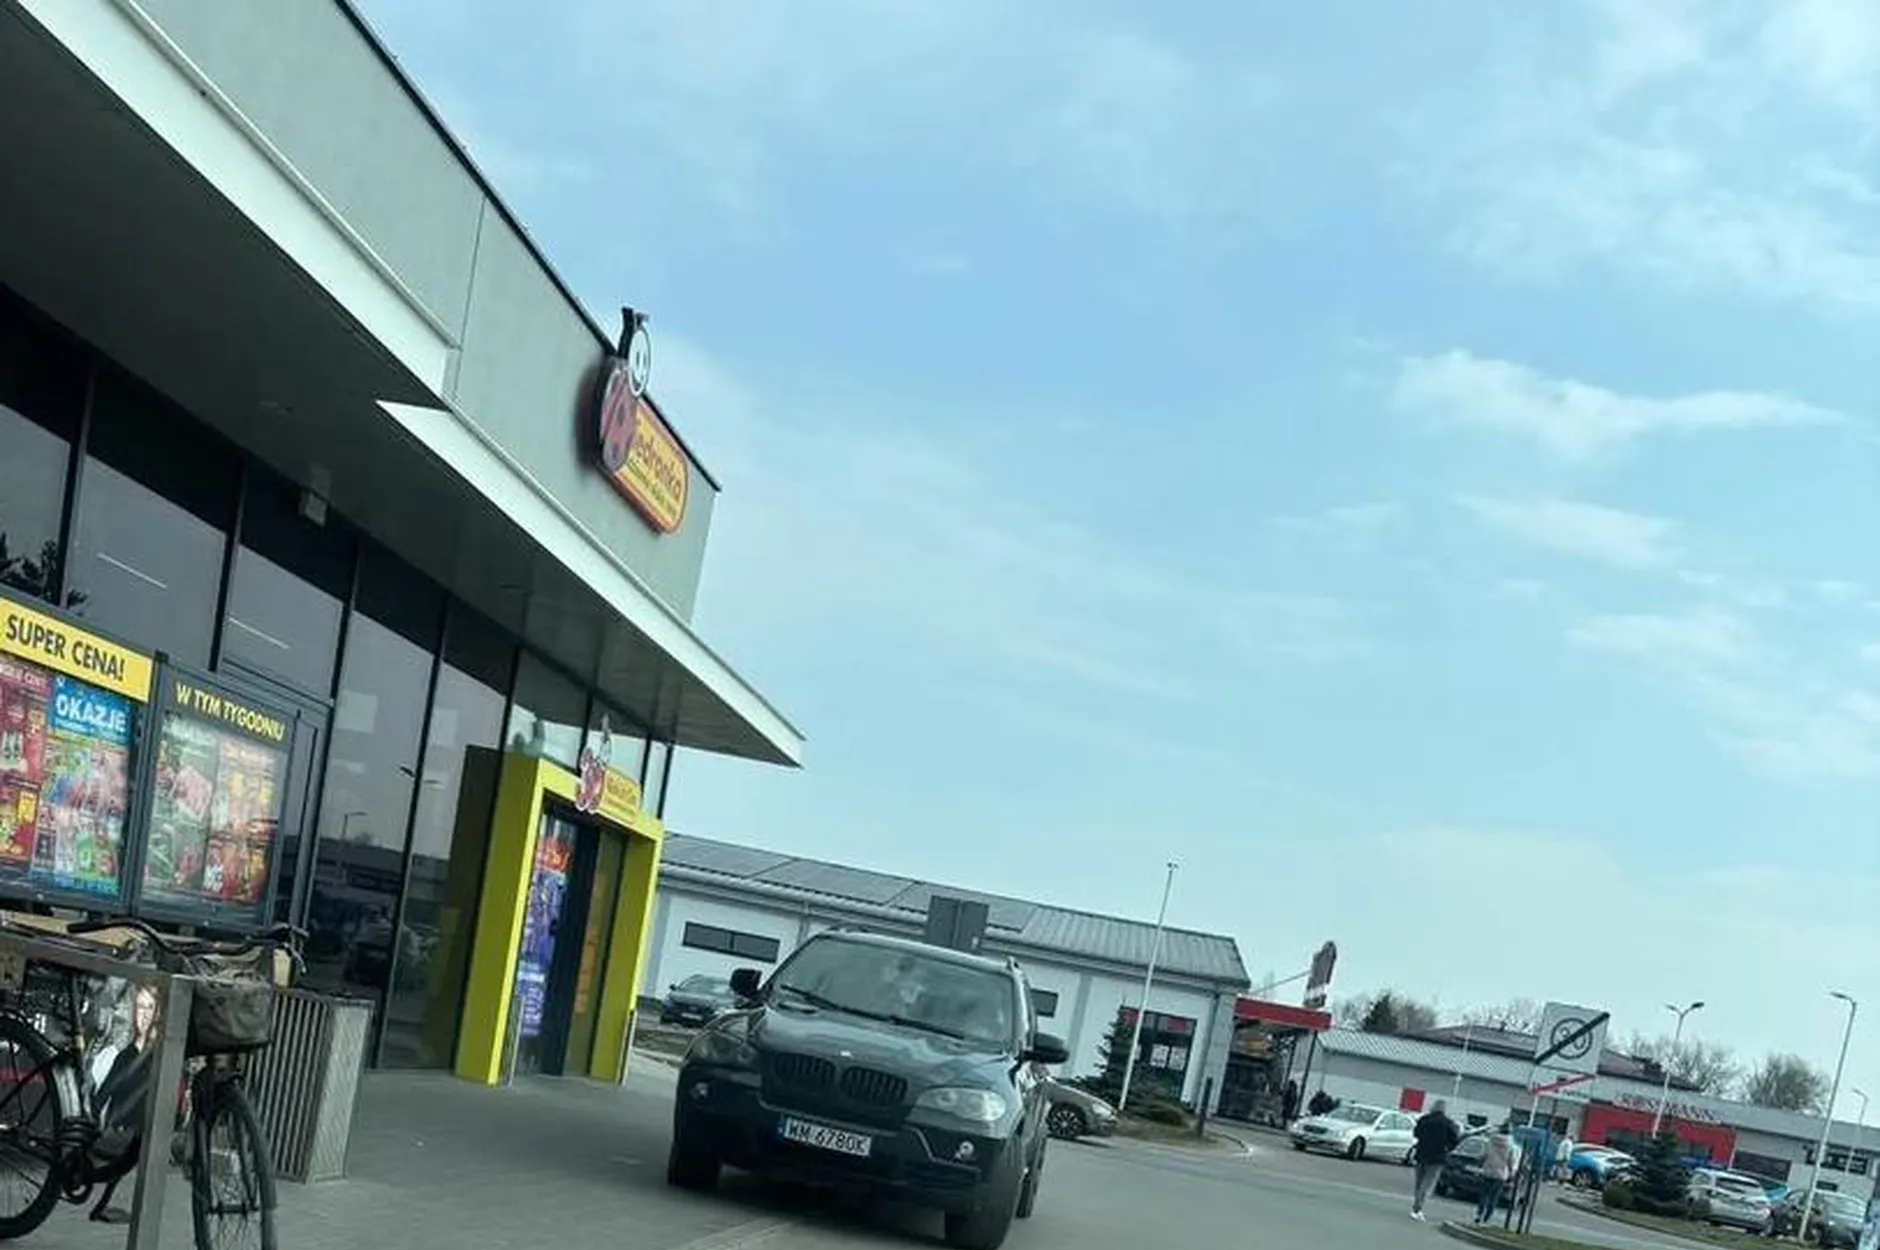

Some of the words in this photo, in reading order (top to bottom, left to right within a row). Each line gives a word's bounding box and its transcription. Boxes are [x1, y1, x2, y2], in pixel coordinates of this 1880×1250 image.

[5, 614, 66, 660] SUPER
[72, 640, 125, 682] CENA!
[55, 694, 127, 733] OKAZJE
[175, 681, 192, 705] W
[194, 689, 221, 717] TYM
[223, 700, 285, 741] TYGODNIU
